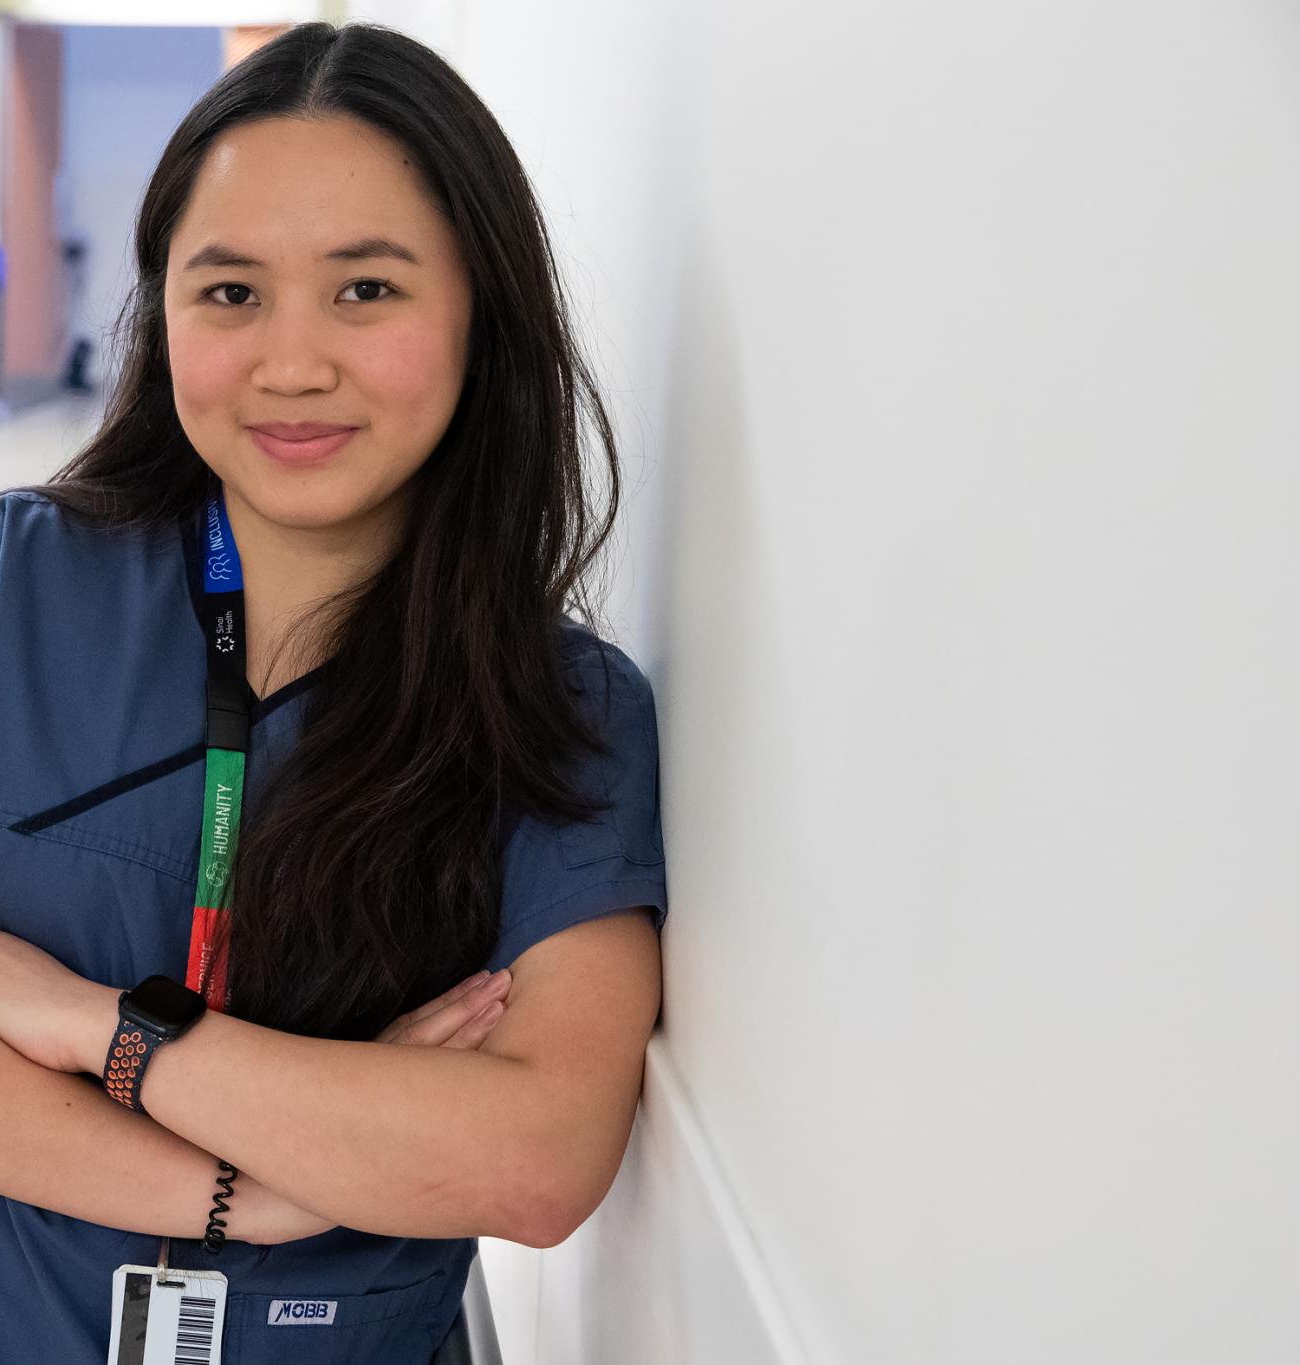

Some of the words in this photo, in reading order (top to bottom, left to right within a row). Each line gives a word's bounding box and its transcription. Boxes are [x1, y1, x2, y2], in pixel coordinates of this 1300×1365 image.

[215, 616, 224, 634] Sinai
[225, 610, 234, 634] Health
[213, 783, 233, 855] HUMANITY
[274, 1302, 329, 1322] MOBB
